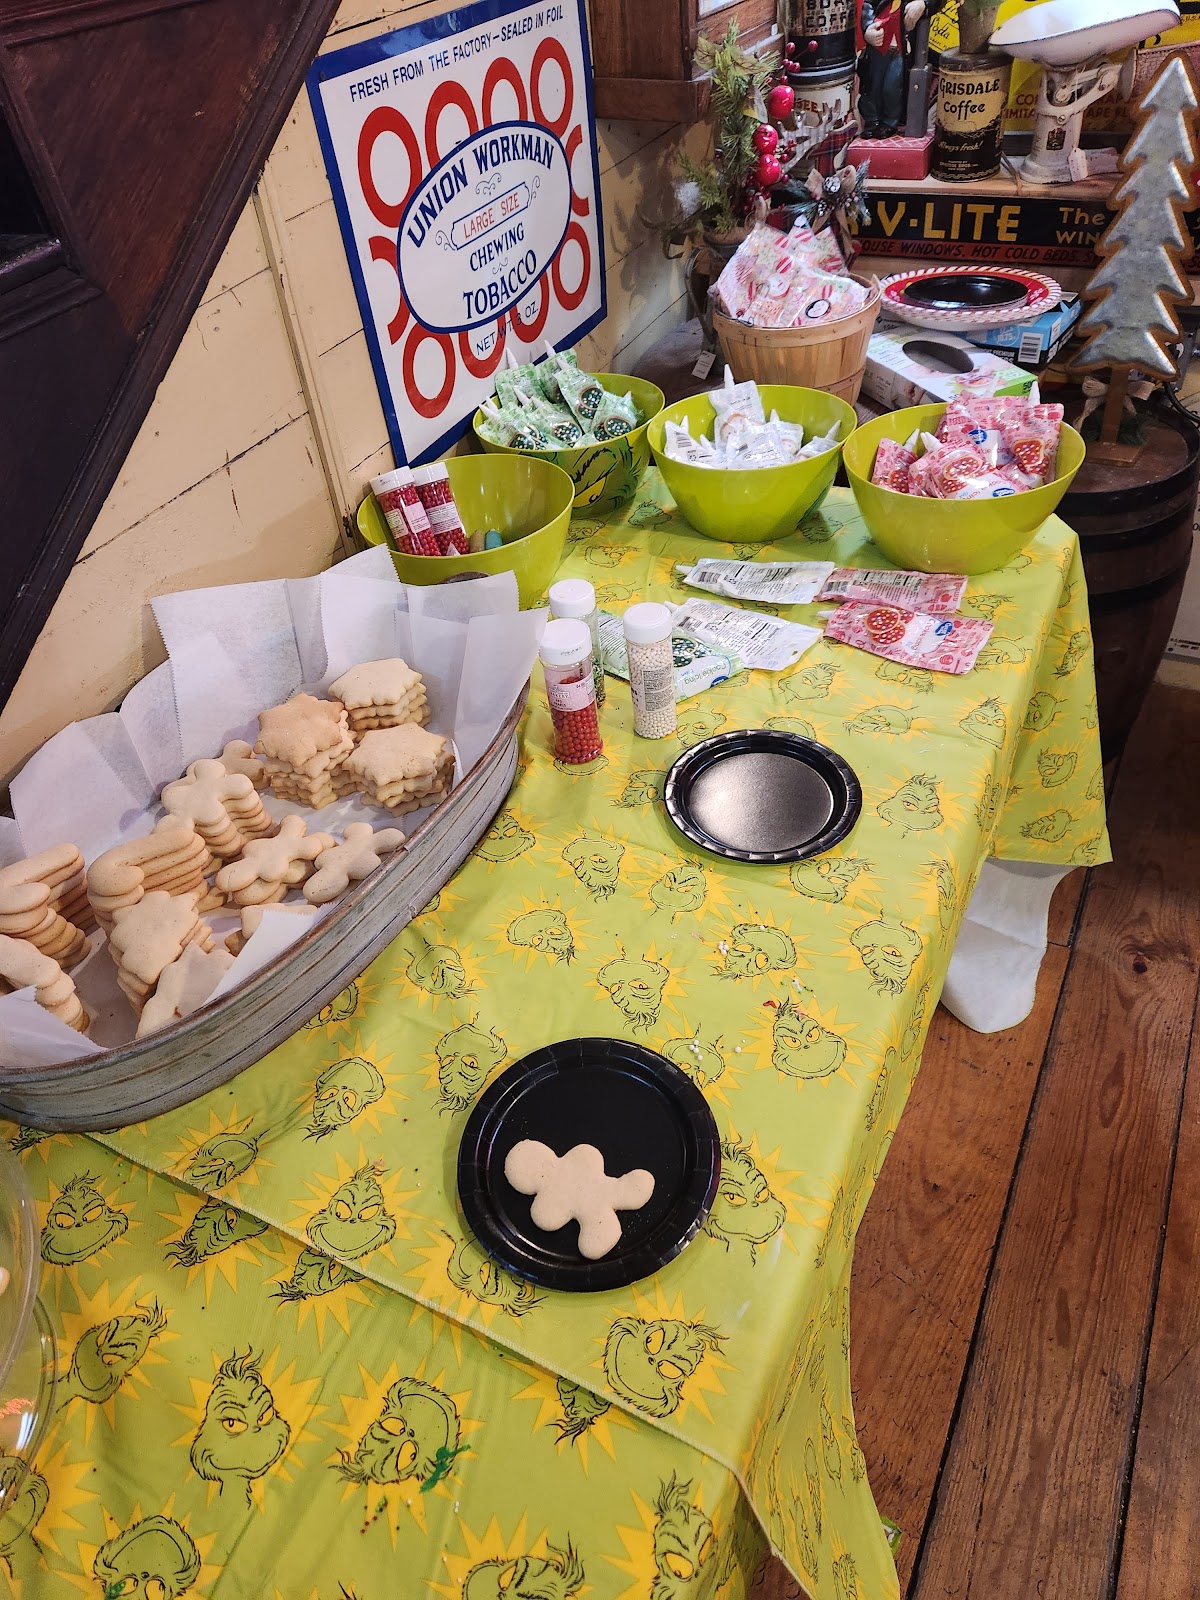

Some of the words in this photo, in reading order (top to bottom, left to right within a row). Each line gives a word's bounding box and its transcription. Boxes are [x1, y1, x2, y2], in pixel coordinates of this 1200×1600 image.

[349, 71, 390, 103] FRESH
[392, 61, 425, 86] FROM
[428, 50, 451, 73] THE
[535, 13, 544, 29] IN
[546, 4, 564, 26] FOIL
[939, 77, 1000, 100] GRISDALE
[943, 100, 986, 121] Coffee
[1004, 108, 1038, 119] IMITA
[406, 158, 470, 249] UNION
[472, 133, 556, 176] WORKMAN
[463, 208, 496, 239] LARGE
[500, 192, 521, 218] SIZE
[1058, 206, 1106, 226] The
[469, 221, 526, 272] CHEWING
[859, 240, 895, 254] OUSE
[970, 245, 1000, 259] HOT
[1004, 245, 1040, 260] COLD
[462, 249, 538, 320] TOBACCO
[475, 331, 497, 356] NET
[515, 312, 524, 326] 3
[684, 673, 702, 685] Icing
[702, 662, 727, 677] Cookie
